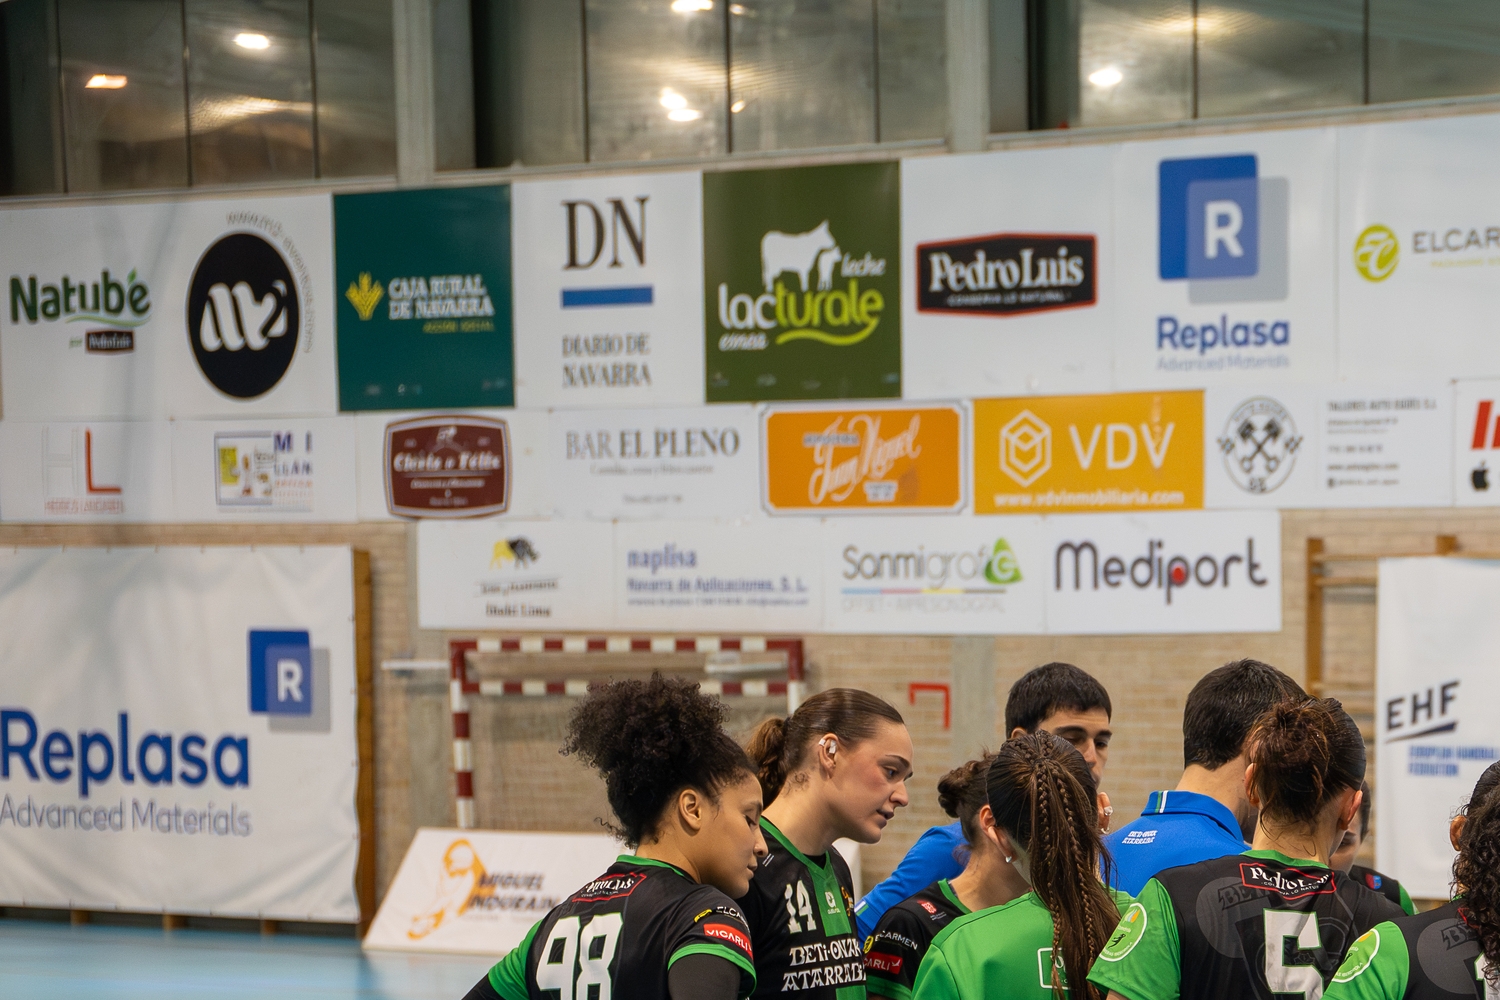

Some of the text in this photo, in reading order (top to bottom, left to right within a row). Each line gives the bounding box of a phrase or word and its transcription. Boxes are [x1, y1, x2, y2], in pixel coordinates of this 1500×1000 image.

[560, 195, 651, 270] DN
[1205, 199, 1244, 260] R
[718, 279, 885, 331] lacturale
[562, 333, 650, 357] DIARIO DE
[1156, 313, 1291, 356] Replasa
[562, 362, 652, 388] NAVARRA
[565, 427, 740, 460] BAR EL PLENO
[1070, 422, 1176, 470] VDV
[1056, 538, 1268, 604] Mediport
[277, 660, 304, 702] R
[1386, 679, 1460, 732] EHF
[0, 709, 249, 798] Replasa
[0, 797, 252, 837] Advanced Materials
